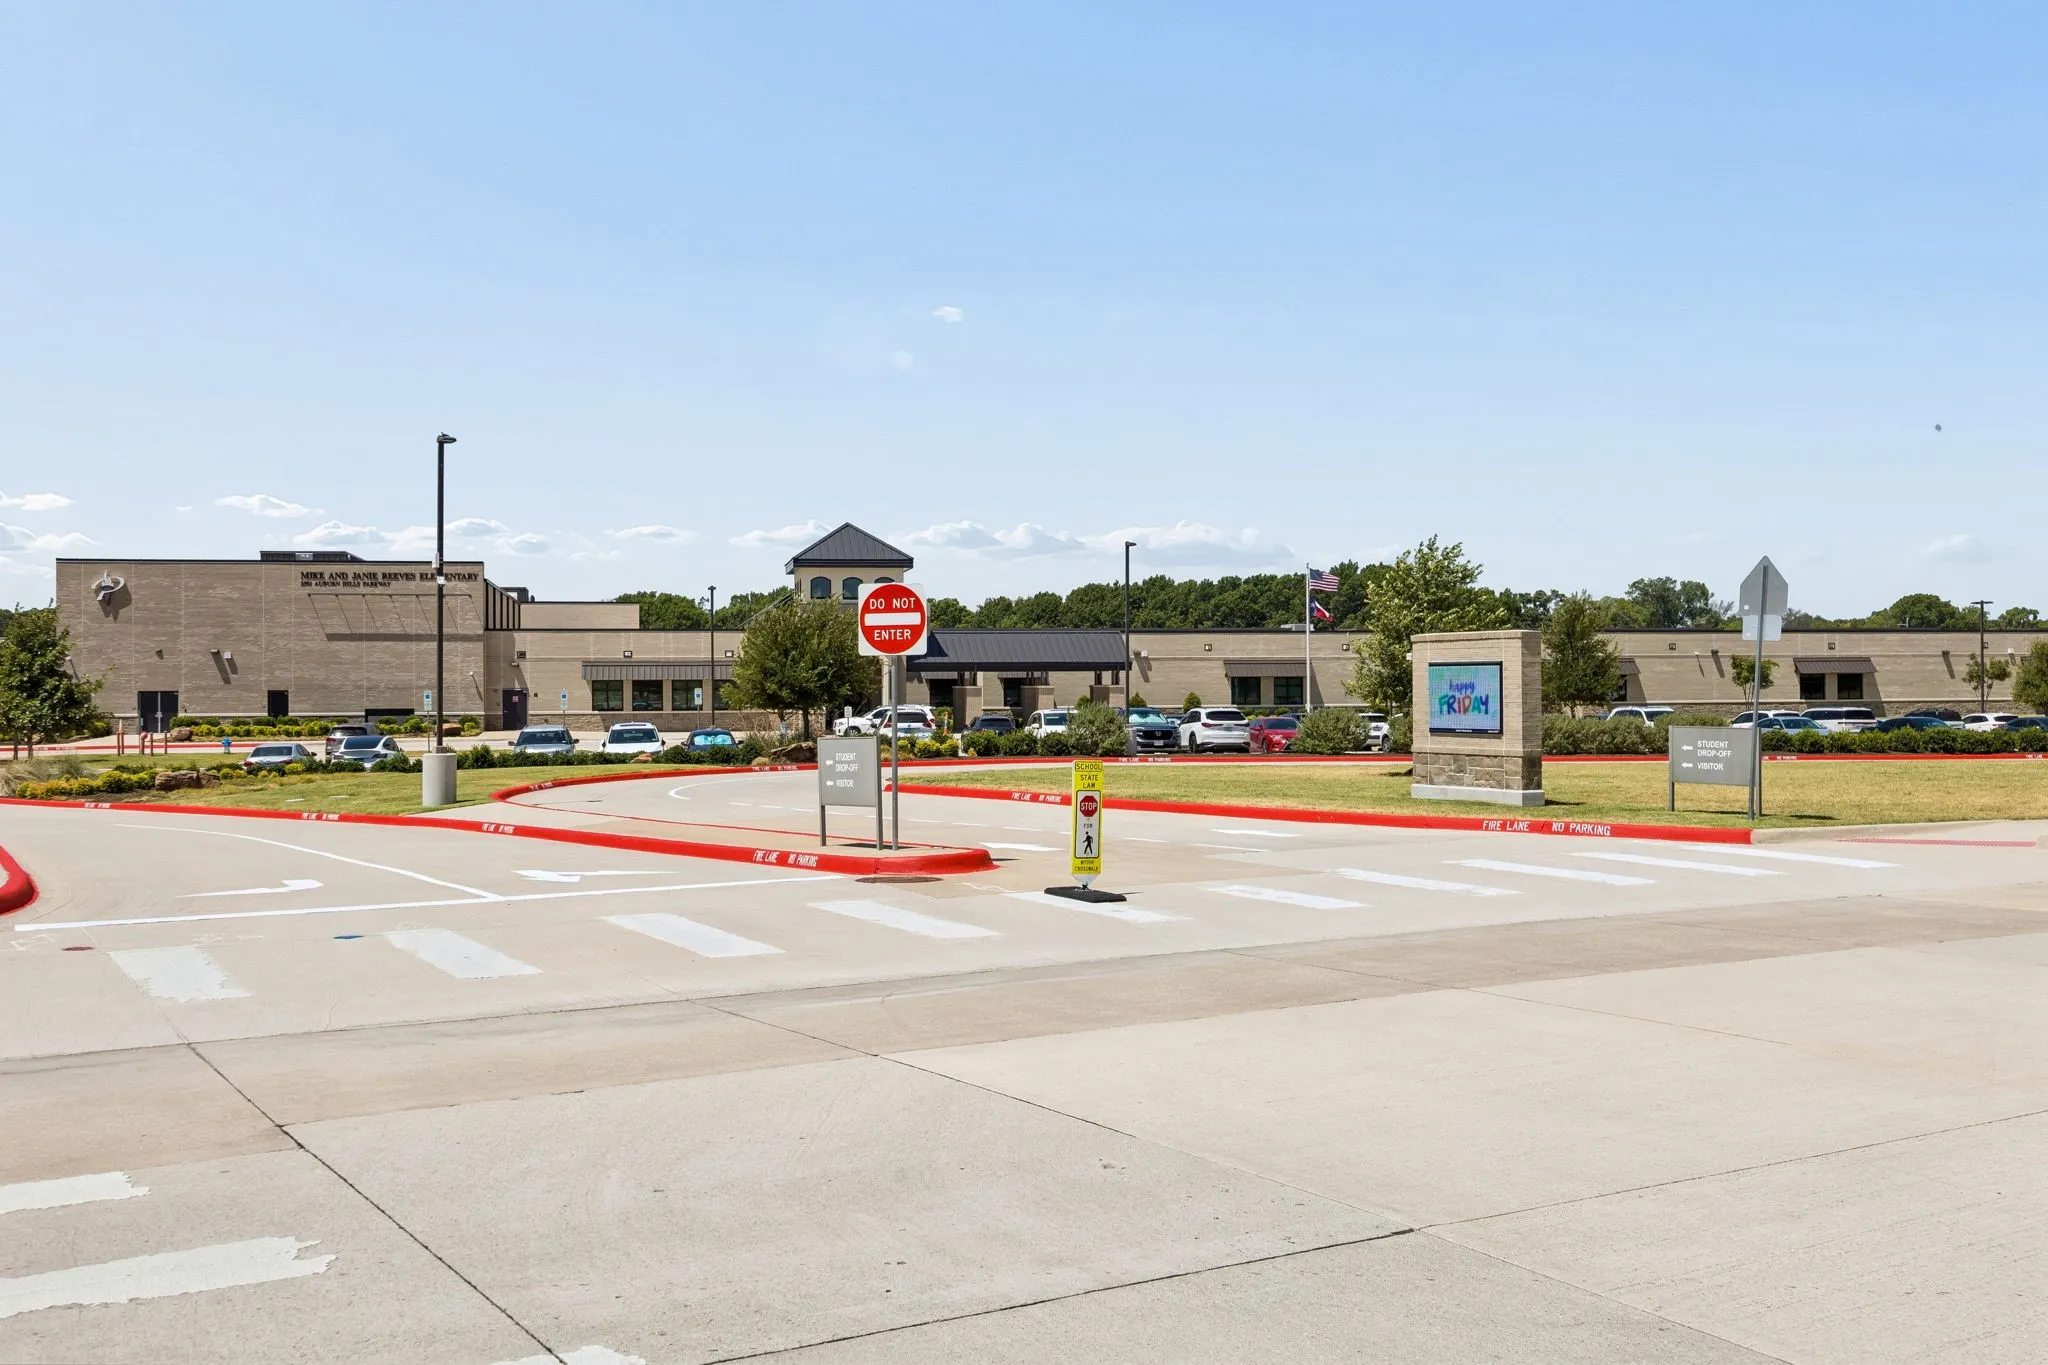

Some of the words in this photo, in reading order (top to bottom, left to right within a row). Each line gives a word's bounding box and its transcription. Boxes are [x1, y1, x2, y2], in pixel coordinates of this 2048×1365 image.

[301, 571, 325, 580] MIKE
[329, 572, 349, 581] AND
[382, 572, 416, 581] REEVES
[420, 572, 479, 581] ELEENTARY
[870, 598, 885, 610] DO
[893, 597, 916, 609] NOT
[875, 629, 912, 641] ENTER
[1438, 694, 1489, 716] FRIDAY
[1697, 740, 1729, 749] STUDENT
[835, 753, 856, 761] STUDENT
[1697, 749, 1732, 758] DROP-OFF
[835, 763, 859, 772] DROP-OFF
[1076, 763, 1101, 771] SCHOOL
[1697, 762, 1724, 770] VISITOR
[1080, 774, 1098, 782] STATE
[836, 779, 854, 787] VISITOR
[1080, 802, 1098, 811] STOP
[1482, 820, 1503, 832] FIRE
[1506, 821, 1531, 832] LANE
[1551, 822, 1566, 833] NO
[1569, 823, 1611, 836] PARKING
